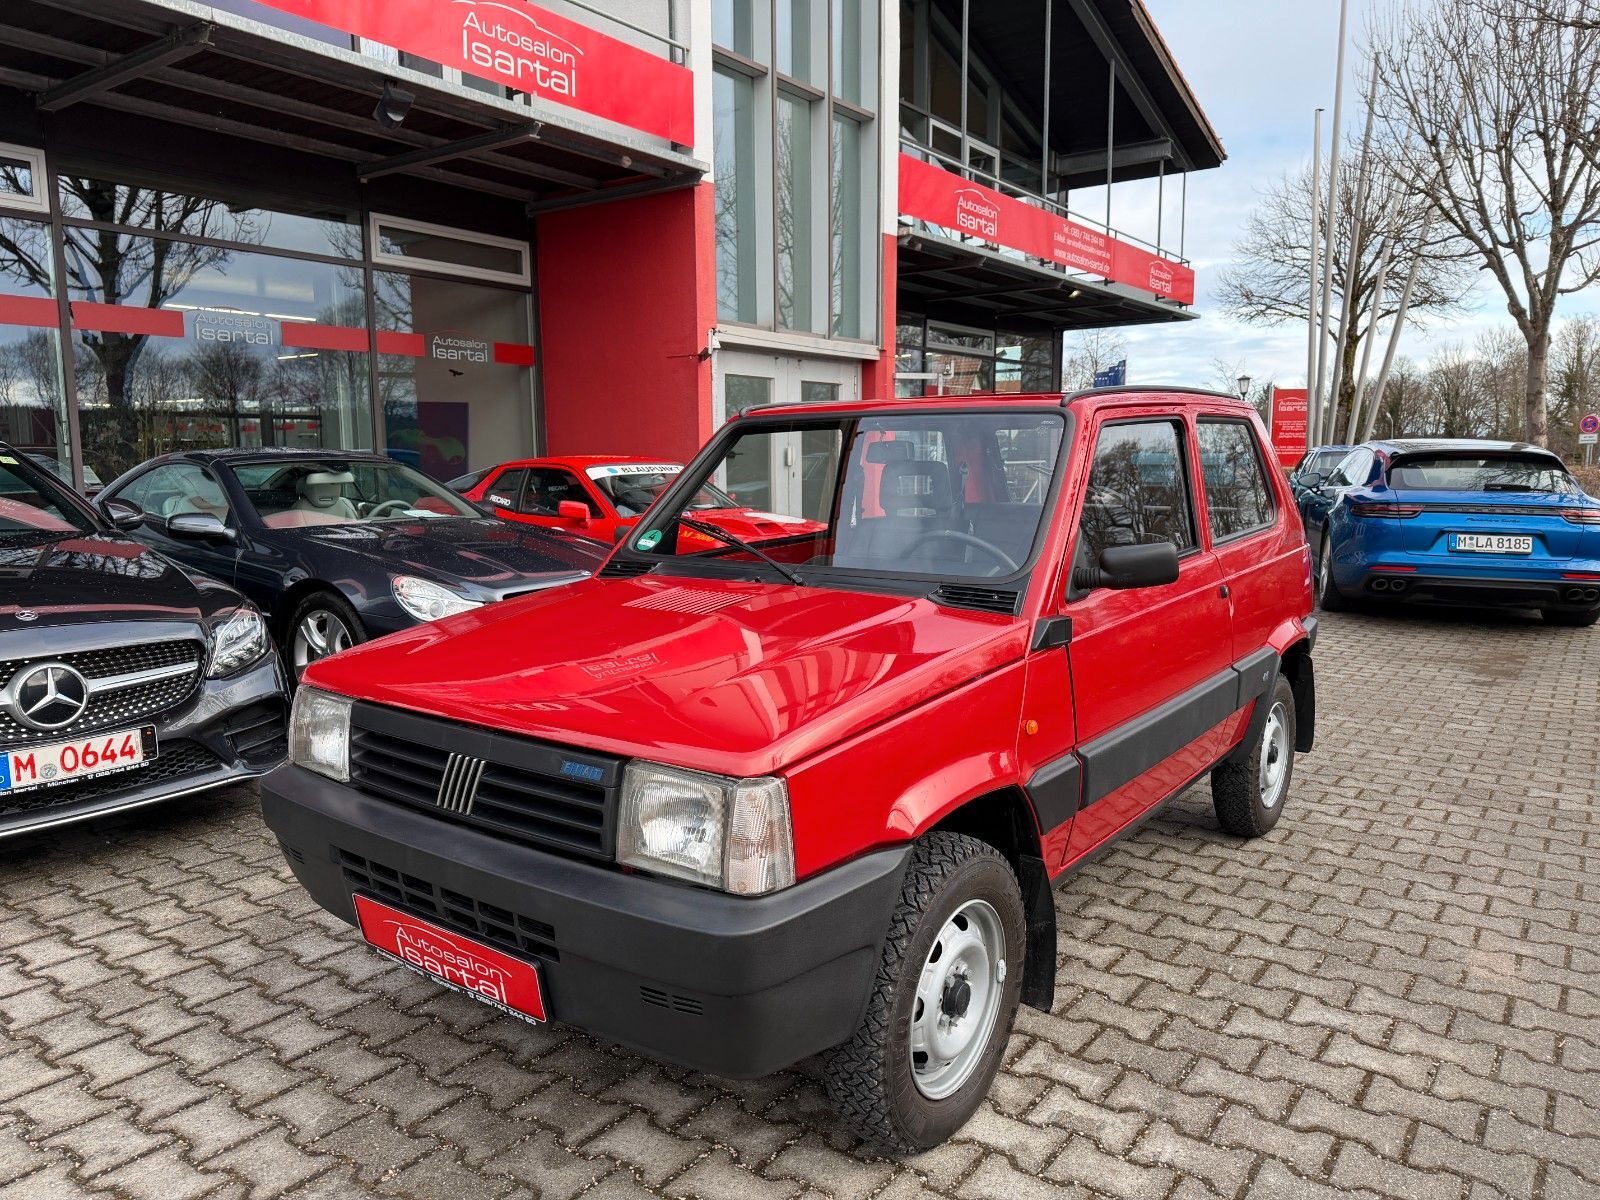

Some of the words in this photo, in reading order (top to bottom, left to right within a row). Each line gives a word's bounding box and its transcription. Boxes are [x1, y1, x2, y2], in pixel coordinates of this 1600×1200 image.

[463, 11, 576, 68] Autosalon
[463, 29, 576, 98] Isartal
[958, 195, 998, 219] Autosalon
[957, 206, 998, 237] Isartal
[1151, 265, 1172, 280] Autosalon
[1150, 274, 1172, 293] Isartal
[195, 313, 273, 330] Autosalon
[195, 323, 274, 345] Isartal
[433, 335, 488, 349] Autosalon
[432, 344, 488, 363] Isartal
[621, 465, 680, 474] BLAUPUNKT
[649, 530, 660, 541] 4
[1457, 536, 1467, 548] M
[1475, 536, 1493, 549] LA
[1496, 537, 1531, 550] 8185
[13, 753, 37, 782] M
[59, 734, 137, 773] 0644
[13, 785, 38, 795] Isartal
[47, 777, 79, 788] München
[396, 926, 503, 980] Autosalon
[396, 936, 507, 1004] Isartal
